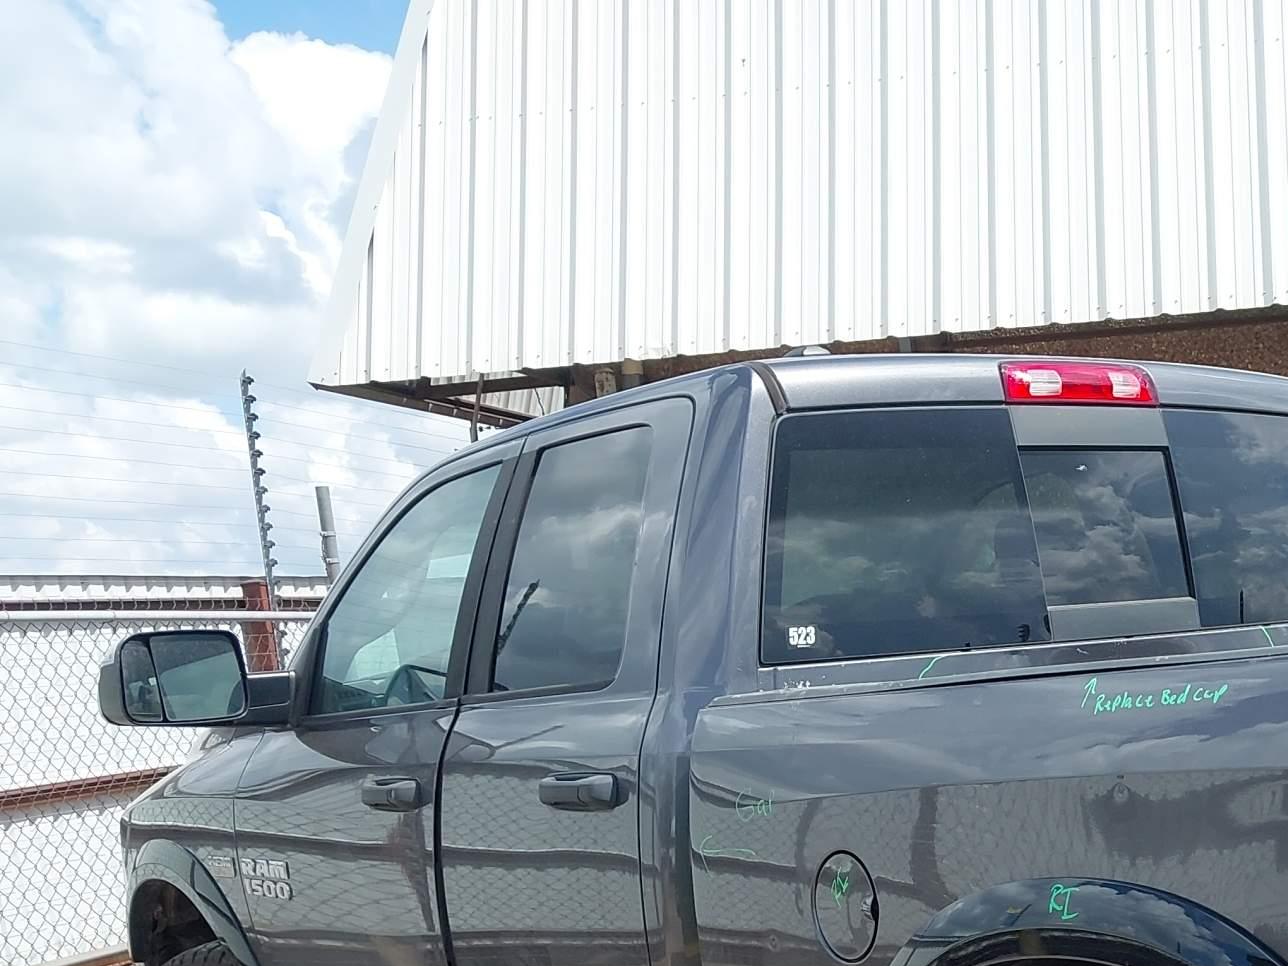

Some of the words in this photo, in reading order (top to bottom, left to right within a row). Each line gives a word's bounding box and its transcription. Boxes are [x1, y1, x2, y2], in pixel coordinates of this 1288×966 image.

[788, 625, 816, 646] 523
[1094, 691, 1155, 715] Replace
[1160, 684, 1191, 704] Bed
[240, 858, 288, 879] RAM
[244, 878, 292, 900] 1500
[1048, 883, 1080, 920] RI
